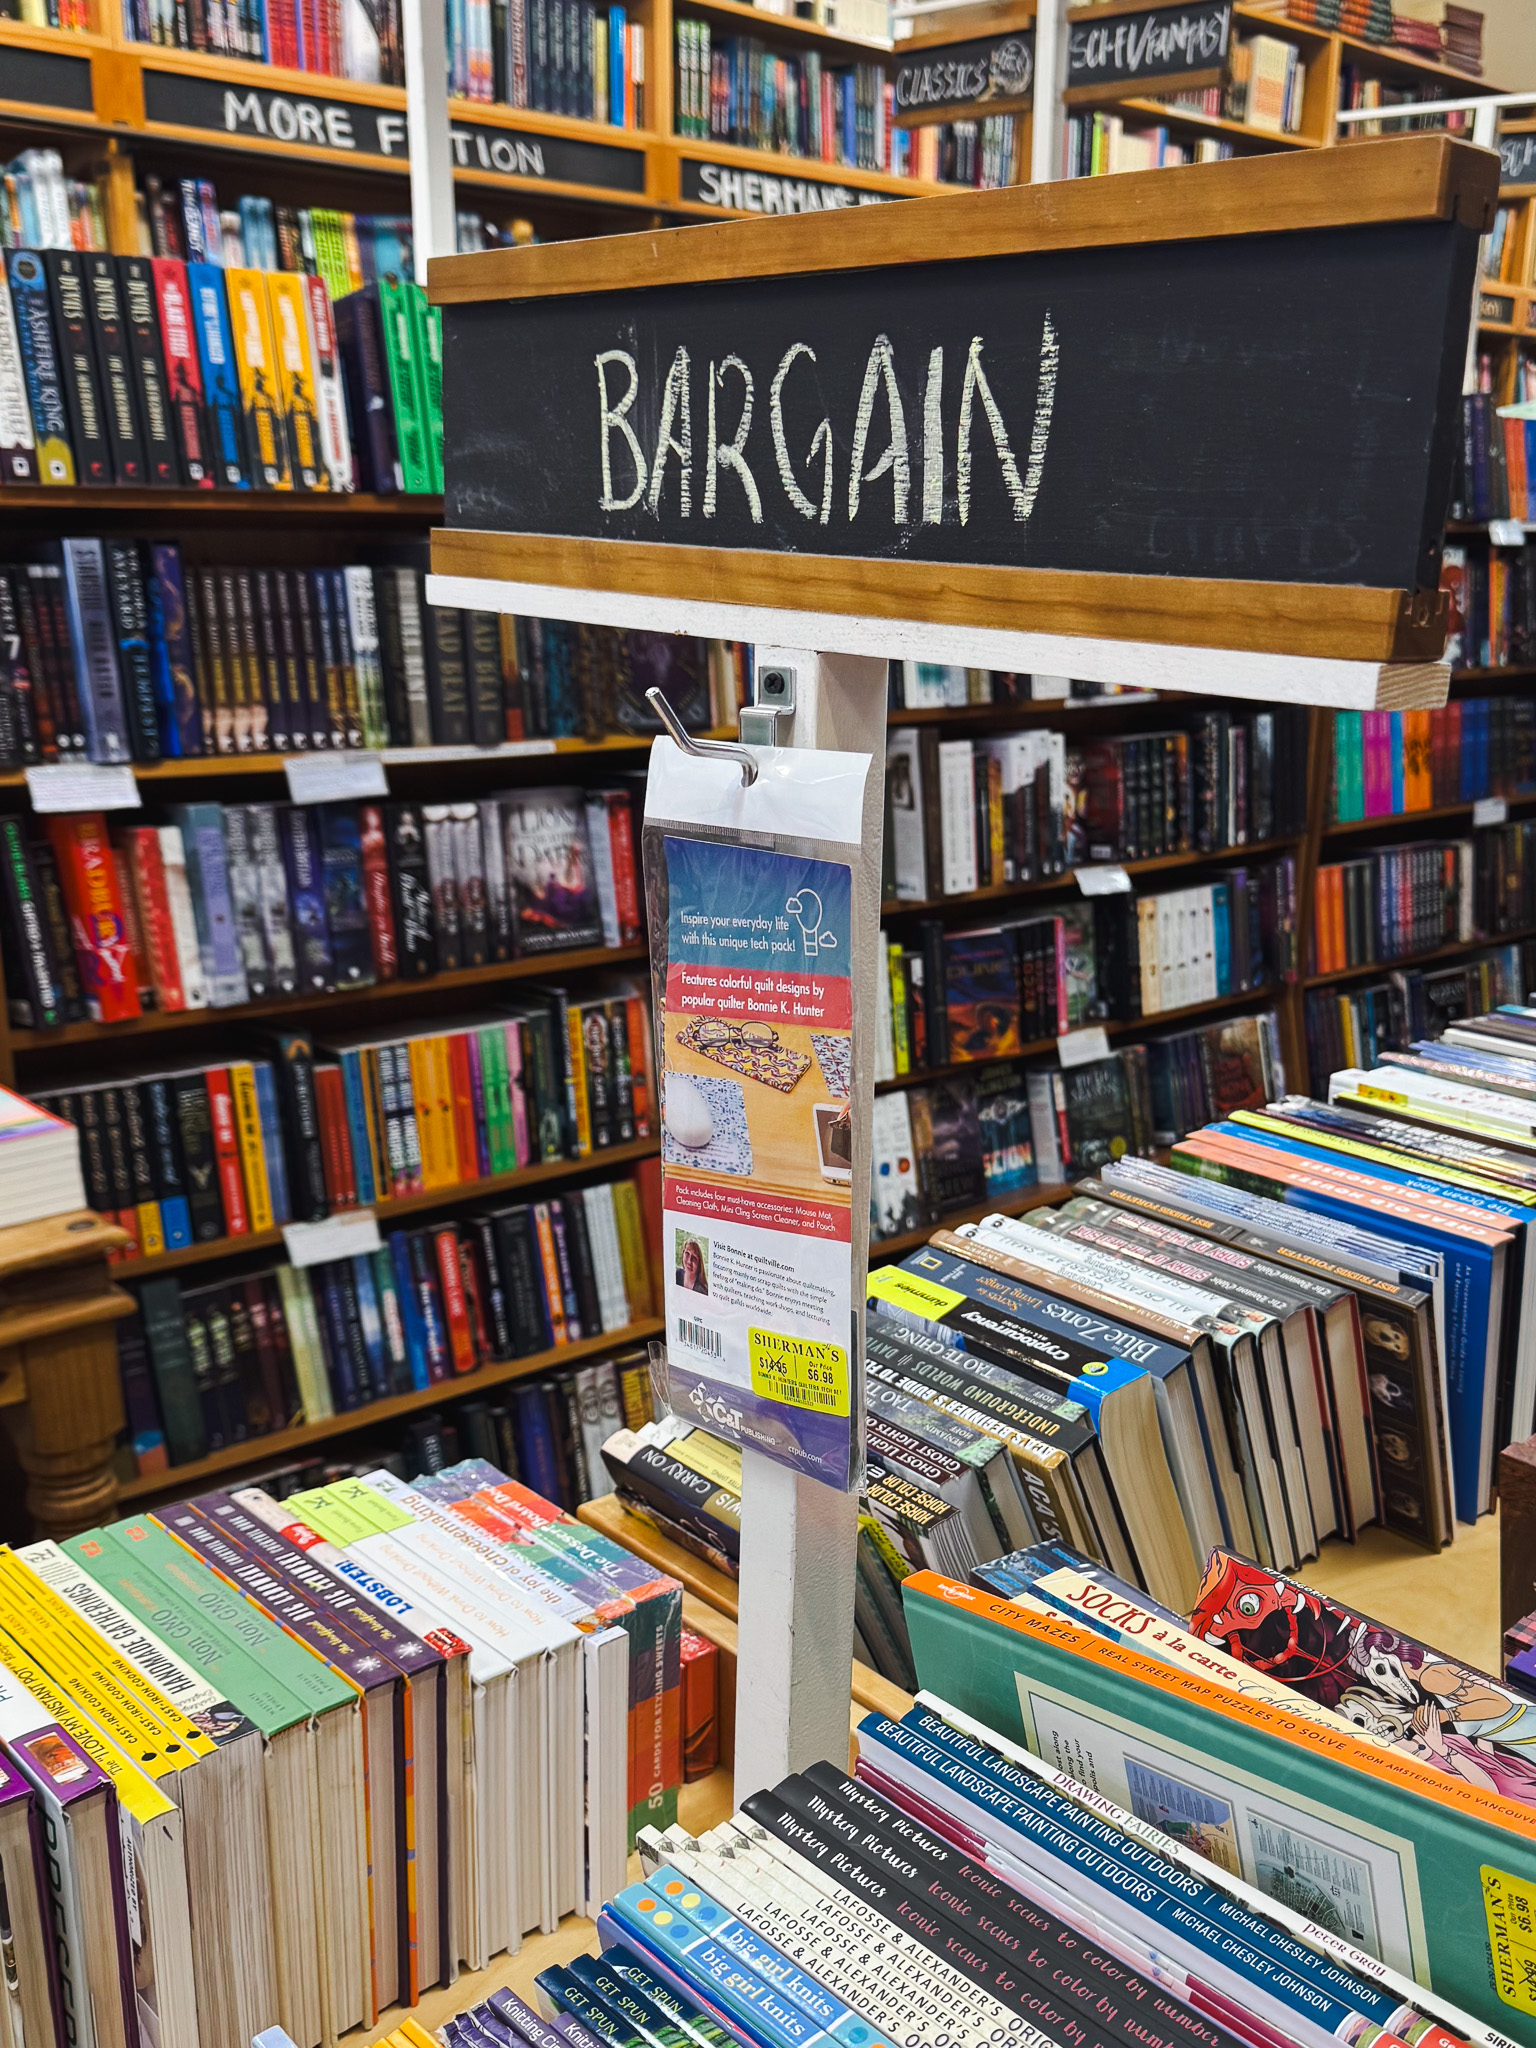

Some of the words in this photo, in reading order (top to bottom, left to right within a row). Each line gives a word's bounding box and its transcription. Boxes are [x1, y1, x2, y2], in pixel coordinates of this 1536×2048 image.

[225, 89, 355, 148] MORE
[377, 115, 545, 176] FTION
[595, 307, 1060, 526] BARGAIN
[681, 911, 708, 925] Inspire
[711, 915, 730, 929] your
[732, 916, 773, 931] everyday
[775, 916, 789, 931] life
[682, 932, 699, 945] with
[702, 933, 716, 946] this
[719, 937, 748, 951] unique
[751, 938, 768, 950] tech
[772, 940, 795, 954] pack!
[681, 972, 717, 987] Features
[720, 974, 751, 990] colorful
[755, 978, 774, 994] quilt
[777, 980, 810, 998] designs
[813, 983, 824, 999] by
[682, 993, 715, 1008] popular
[717, 996, 745, 1010] quilter
[748, 998, 777, 1013] Bonnie
[781, 1001, 790, 1014] K.
[794, 1002, 825, 1017] Hunter
[676, 1185, 689, 1196] Pack
[691, 1188, 713, 1200] includes
[715, 1192, 725, 1202] four
[727, 1194, 755, 1207] must-have
[757, 1200, 793, 1213] accessories:
[796, 1206, 816, 1218] Mouse
[819, 1210, 833, 1222] Mat,
[676, 1197, 701, 1210] Cleaning
[703, 1200, 718, 1212] Cloth,
[721, 1204, 733, 1215] Mini
[735, 1207, 750, 1220] Cling
[752, 1211, 772, 1222] Screen
[774, 1214, 800, 1227] Cleaner,
[802, 1219, 814, 1229] and
[817, 1220, 835, 1232] Pouch
[713, 1241, 726, 1251] Visit
[727, 1244, 746, 1258] Bonnie
[747, 1251, 753, 1260] at
[754, 1252, 795, 1273] quiltville.com
[894, 1281, 949, 1307] dummies
[976, 1276, 1013, 1296] Longer
[989, 1292, 1021, 1311] Secrets
[1013, 1289, 1042, 1310] Living
[960, 1311, 1070, 1361] Cryptocurrency
[1042, 1303, 1109, 1341] Zones
[754, 1333, 839, 1363] SHERMAN'S
[896, 1326, 947, 1356] CHING
[947, 1349, 967, 1363] TE
[1101, 1327, 1162, 1363] Blue
[808, 1368, 834, 1384] $6.98
[819, 1363, 833, 1371] Price
[911, 1361, 964, 1392] WORLDS
[963, 1356, 996, 1379] TAO
[894, 1376, 936, 1400] GUIDE
[713, 1403, 743, 1430] C&T
[740, 1425, 775, 1445] PUBLISHING
[933, 1394, 1014, 1442] BEGINNER'S
[962, 1385, 1060, 1436] UNDERGROUND
[788, 1445, 822, 1464] ctpub.com
[874, 1423, 925, 1454] LIGHTS
[641, 1450, 668, 1468] ON
[923, 1447, 961, 1473] GHOST
[662, 1462, 711, 1494] CARRY
[882, 1474, 914, 1496] COLOR
[505, 1499, 548, 1529] Board
[912, 1488, 951, 1515] HORSE
[401, 1494, 509, 1567] cheesemaking
[541, 1524, 593, 1560] Dessert
[508, 1561, 522, 1577] of
[520, 1573, 542, 1591] joy
[595, 1556, 625, 1579] The
[335, 1559, 414, 1615] LOBSTER!
[540, 1588, 563, 1605] the
[62, 1582, 138, 1641] GATHERINGS
[197, 1592, 240, 1628] GMO
[233, 1620, 272, 1648] Non
[654, 1624, 664, 1667] SWEETS
[1066, 1584, 1157, 1635] SOCKS
[1152, 1630, 1167, 1641] à
[1166, 1637, 1185, 1653] la
[1188, 1651, 1238, 1681] carte
[112, 1659, 150, 1696] COOKING
[120, 1635, 196, 1696] HANDMADE
[148, 1690, 182, 1723] CAST-IRON
[655, 1671, 666, 1715] STYLING
[989, 1603, 1025, 1620] CITY
[1026, 1618, 1081, 1644] MAZES
[1099, 1647, 1129, 1665] REAL
[1132, 1660, 1179, 1683] STREET
[1181, 1680, 1211, 1696] MAP
[1213, 1692, 1272, 1722] PUZZLES
[1277, 1718, 1297, 1731] TO
[1299, 1729, 1347, 1751] SOLVE
[1354, 1750, 1385, 1767] FROM
[1386, 1764, 1454, 1793] AMSTERDAM
[1456, 1790, 1472, 1800] TO
[653, 1716, 665, 1740] FOR
[653, 1741, 665, 1778] CARDS
[648, 1782, 664, 1809] 50
[1052, 1772, 1123, 1821] DRAWING
[1122, 1814, 1183, 1856] FAIRIES
[919, 1715, 983, 1767] BEAUTIFUL
[982, 1754, 1063, 1807] LANDSCAPE
[1056, 1800, 1125, 1849] PAINTING
[1121, 1841, 1203, 1898] OUTDOORS
[1218, 1902, 1268, 1938] MICHAEL
[1268, 1932, 1321, 1970] CHESLEY
[1320, 1965, 1381, 2006] JOHNSON
[838, 1780, 889, 1823] Mystery
[892, 1816, 949, 1861] Pictures
[958, 1865, 1002, 1898] Iconic
[1006, 1899, 1051, 1932] scenes
[1057, 1931, 1077, 1948] to
[1082, 1950, 1127, 1983] color
[1126, 1978, 1146, 2000] by
[1153, 1997, 1219, 2047] number
[1515, 1896, 1533, 1933] $6.98
[833, 1888, 892, 1934] LAFOSSE
[891, 1932, 903, 1944] &
[901, 1942, 1003, 2017] ALEXANDER'S
[1485, 1876, 1516, 1997] SHERMAN'S
[730, 1928, 762, 1962] big
[758, 1949, 796, 1980] girl
[786, 1974, 834, 2017] knits
[628, 1967, 653, 1991] GET
[648, 1985, 683, 2014] SPUN
